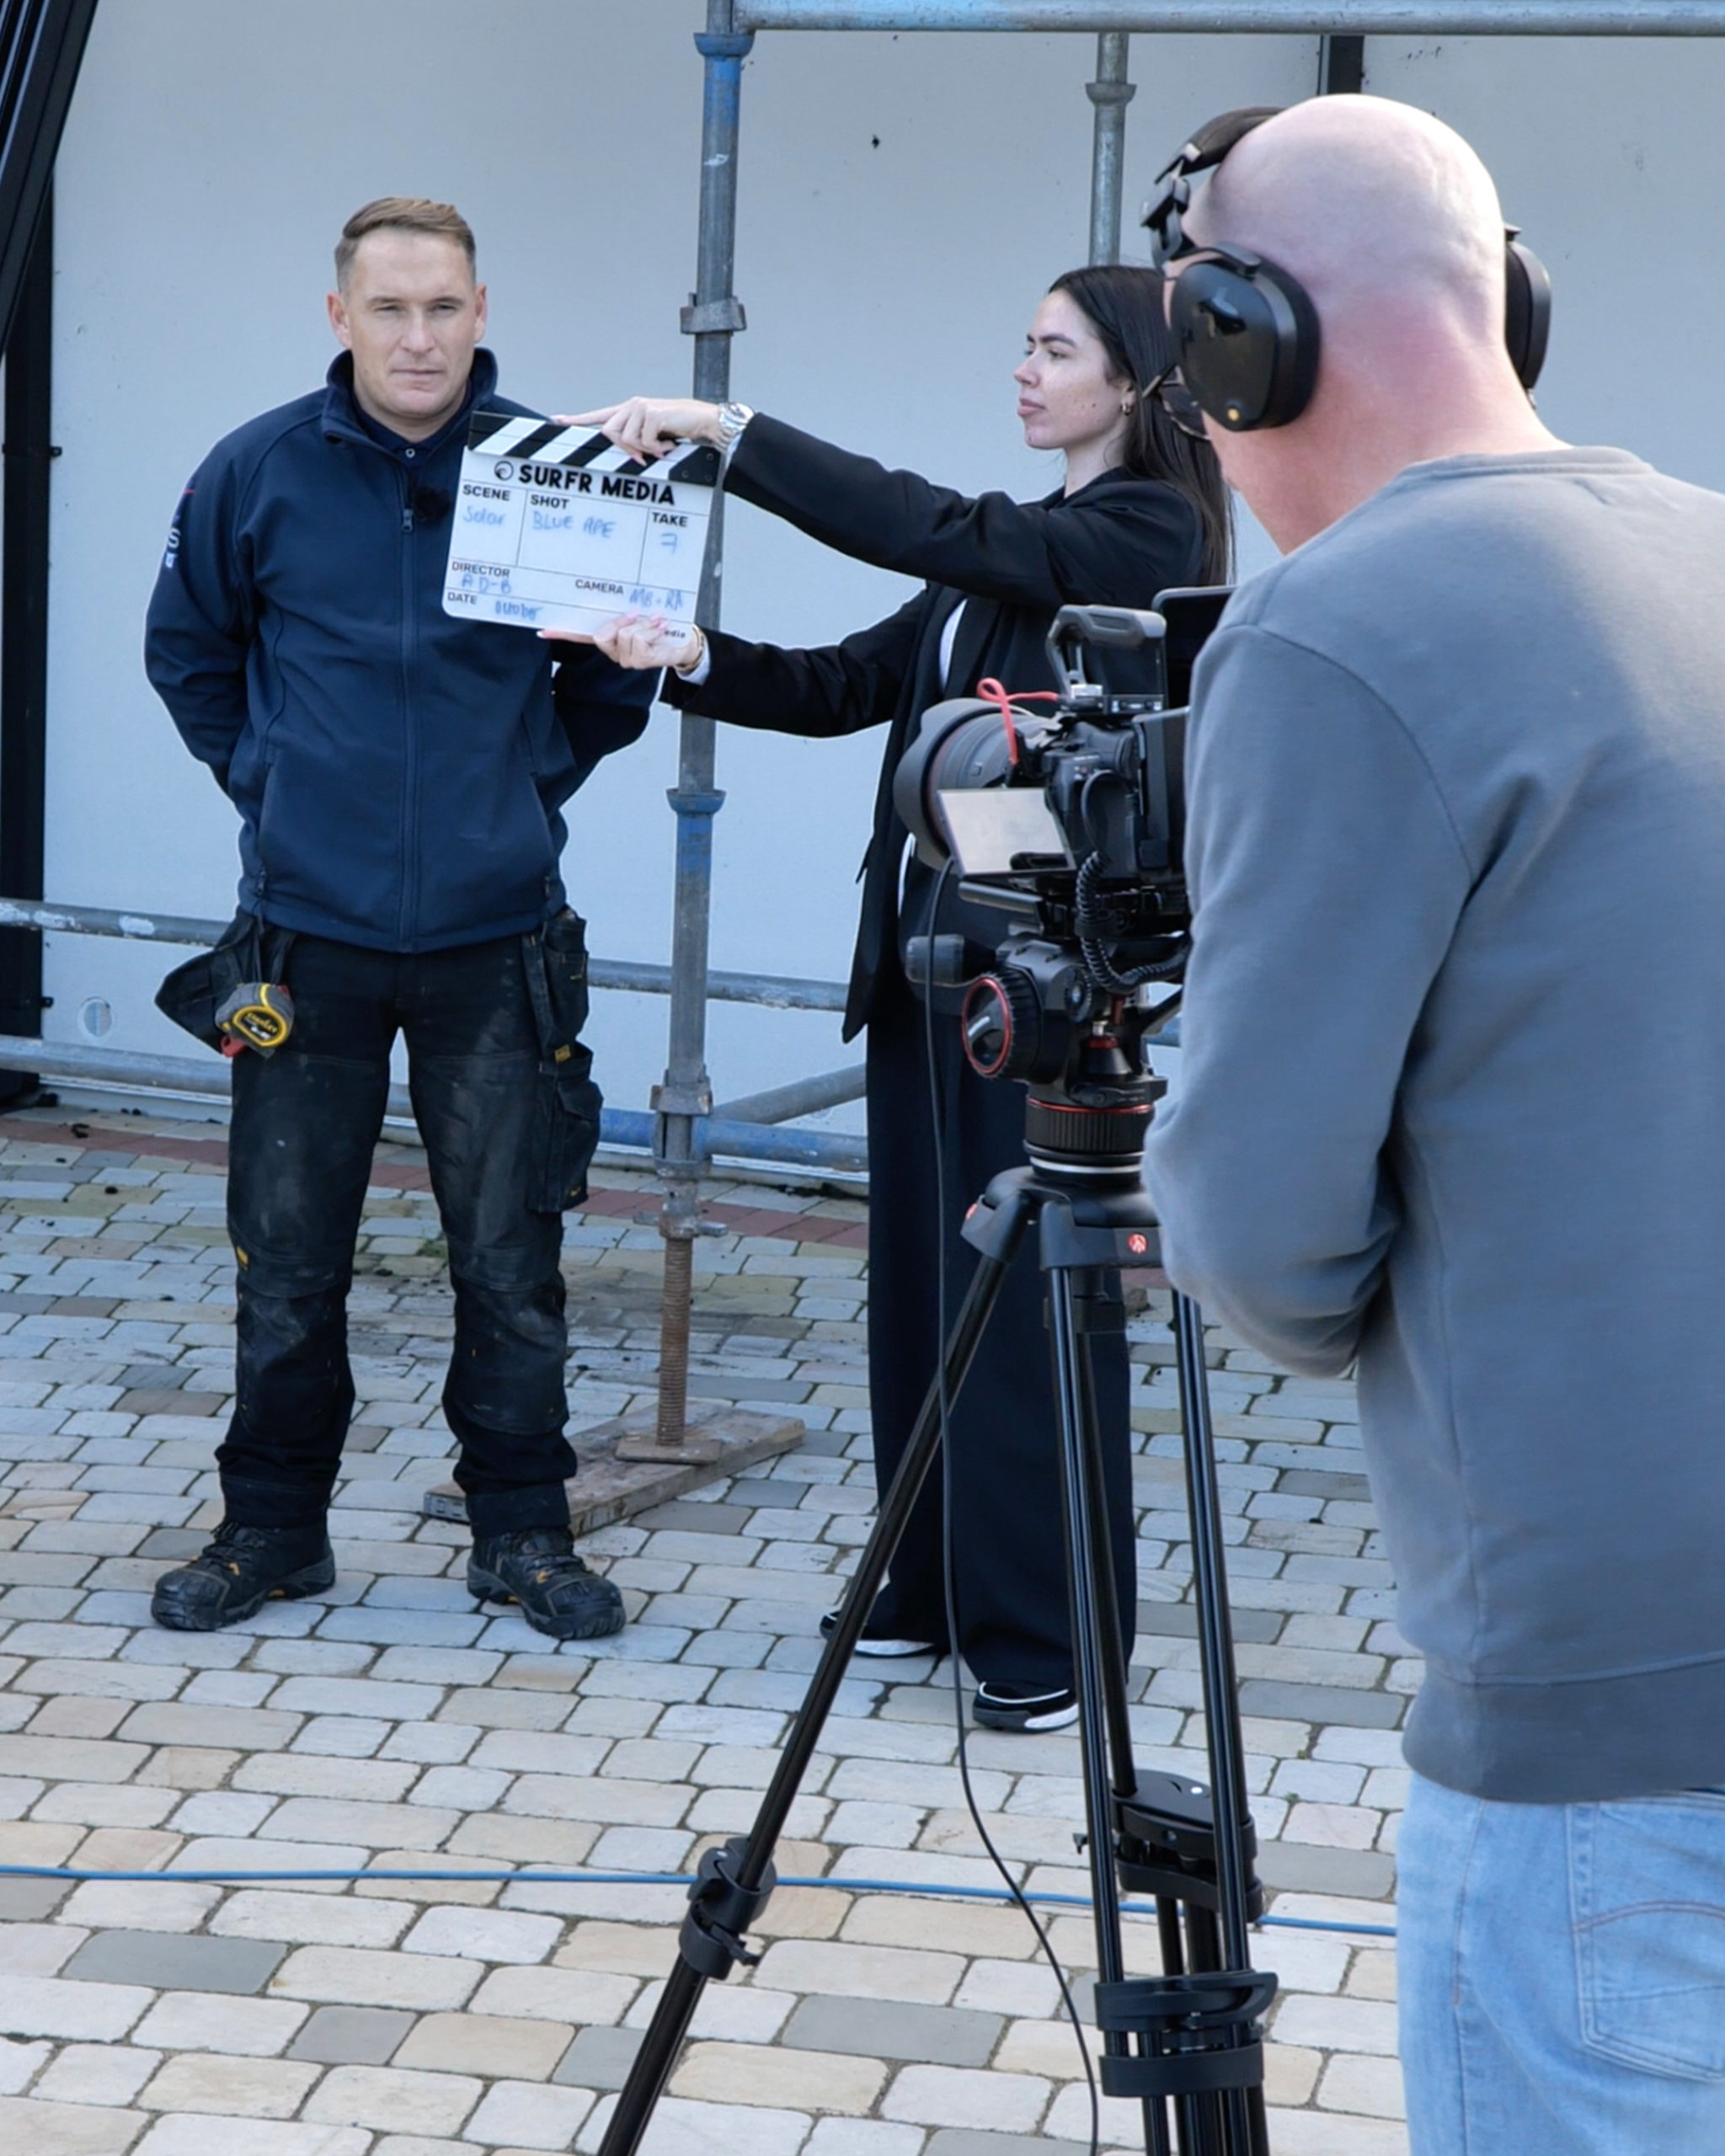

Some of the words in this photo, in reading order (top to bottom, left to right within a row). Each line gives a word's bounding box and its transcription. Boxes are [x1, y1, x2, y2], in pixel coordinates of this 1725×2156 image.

[462, 484, 511, 502] SCENE
[519, 464, 592, 493] SURFR
[601, 476, 675, 505] MEDIA
[531, 494, 570, 510] SHOT
[652, 511, 688, 528] TAKE
[451, 561, 510, 578] DIRECTOR
[575, 579, 624, 595] CAMERA
[447, 592, 478, 605] DATE
